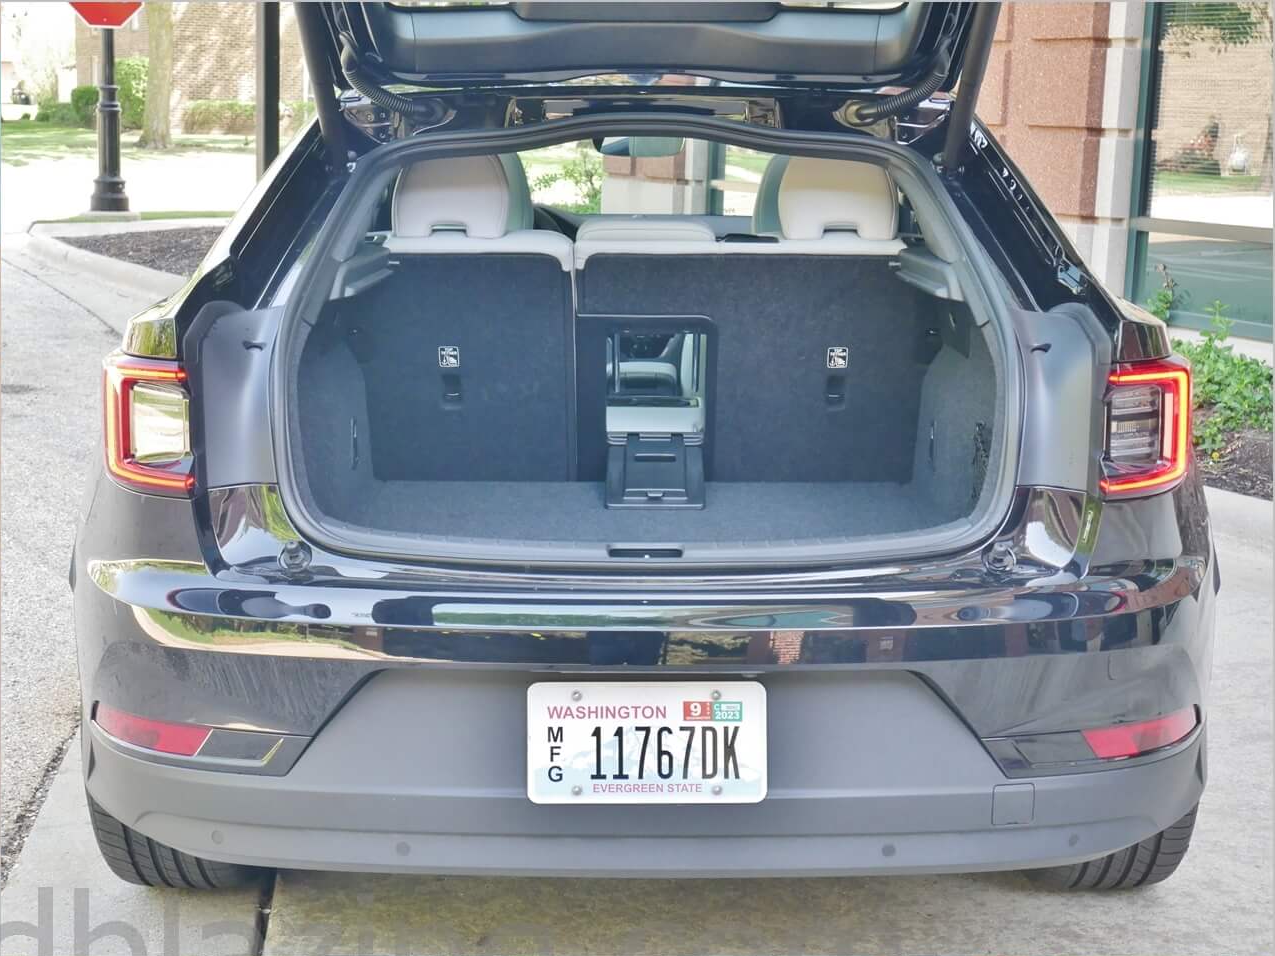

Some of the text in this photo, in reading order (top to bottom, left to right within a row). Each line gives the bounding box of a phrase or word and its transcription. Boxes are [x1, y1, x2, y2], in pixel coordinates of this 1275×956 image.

[547, 706, 667, 719] WASHINGTON
[690, 703, 701, 716] 9
[715, 711, 740, 720] 2023
[590, 726, 741, 780] 11767DK
[593, 783, 702, 793] EVERGREEN STATE
